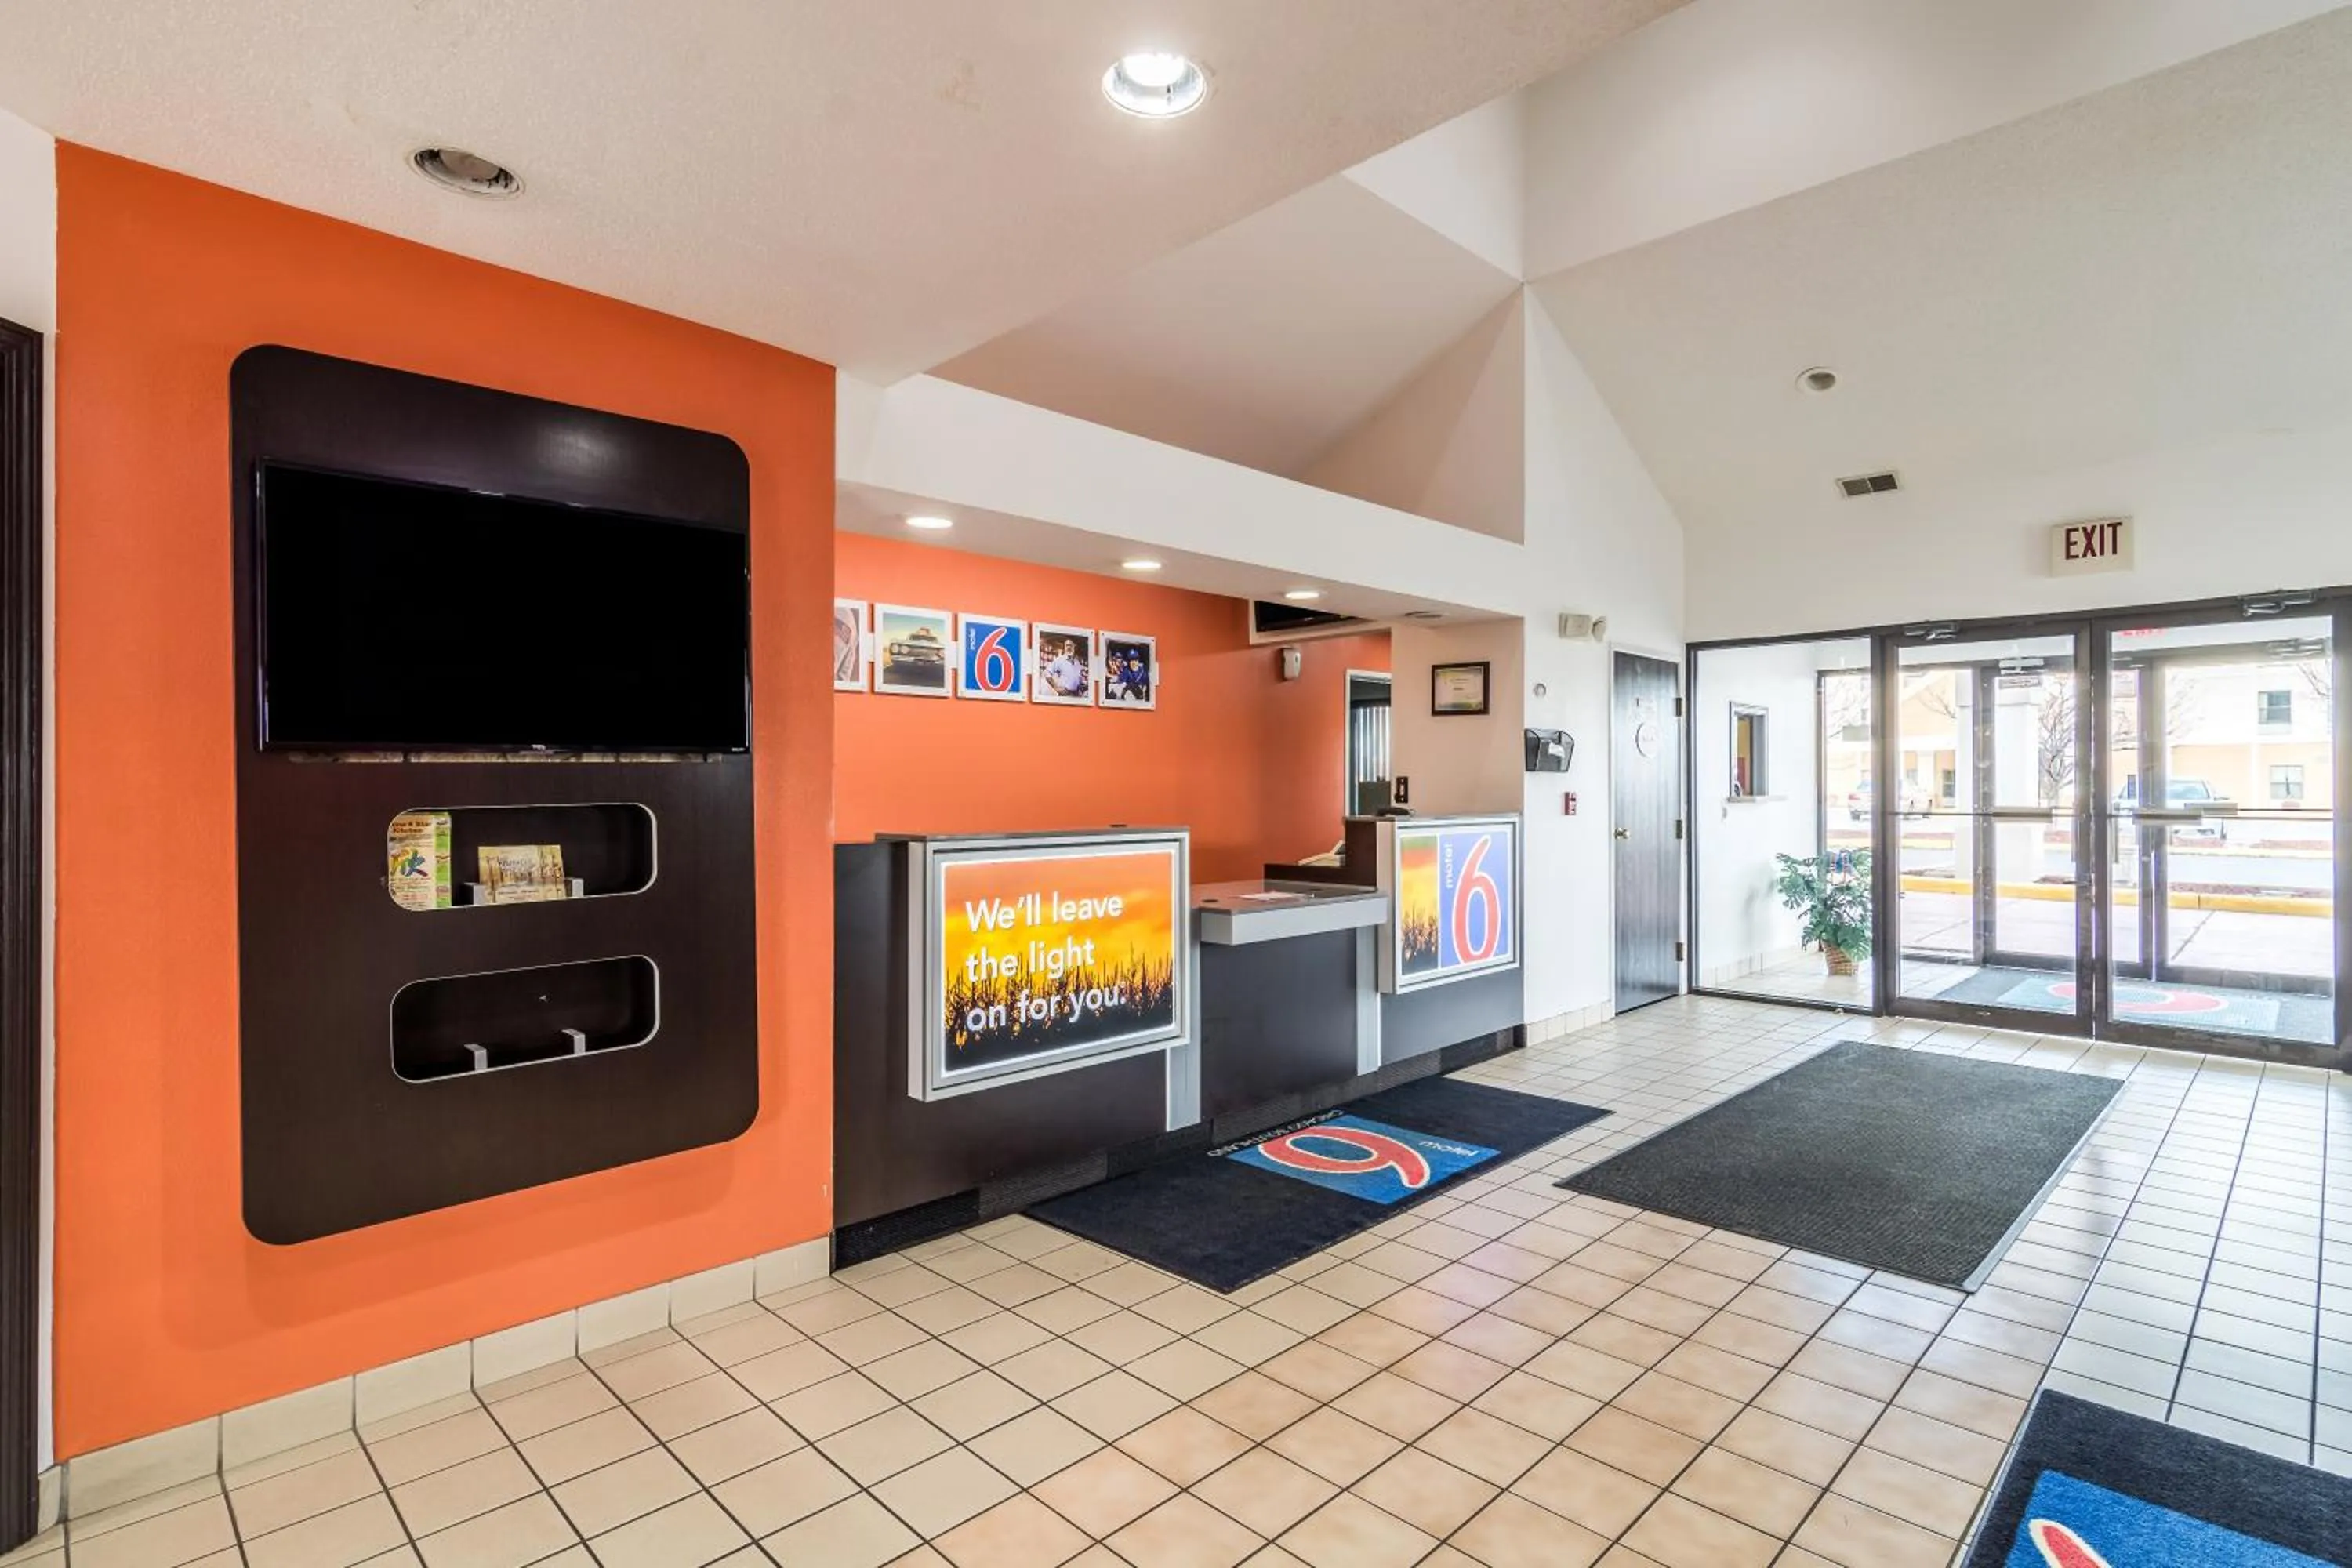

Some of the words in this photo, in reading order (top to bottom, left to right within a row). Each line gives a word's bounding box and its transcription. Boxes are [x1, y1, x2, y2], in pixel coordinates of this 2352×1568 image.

[2064, 521, 2123, 561] EXIT
[975, 626, 1015, 691] 6
[1052, 891, 1123, 924] leave
[1445, 843, 1454, 889] motel
[1451, 834, 1501, 964] 6
[965, 947, 1018, 982] the
[1029, 936, 1095, 979] light
[965, 1002, 1007, 1033] on
[1018, 988, 1062, 1023] for
[1257, 1125, 1431, 1189] 6
[1418, 1141, 1479, 1157] motel
